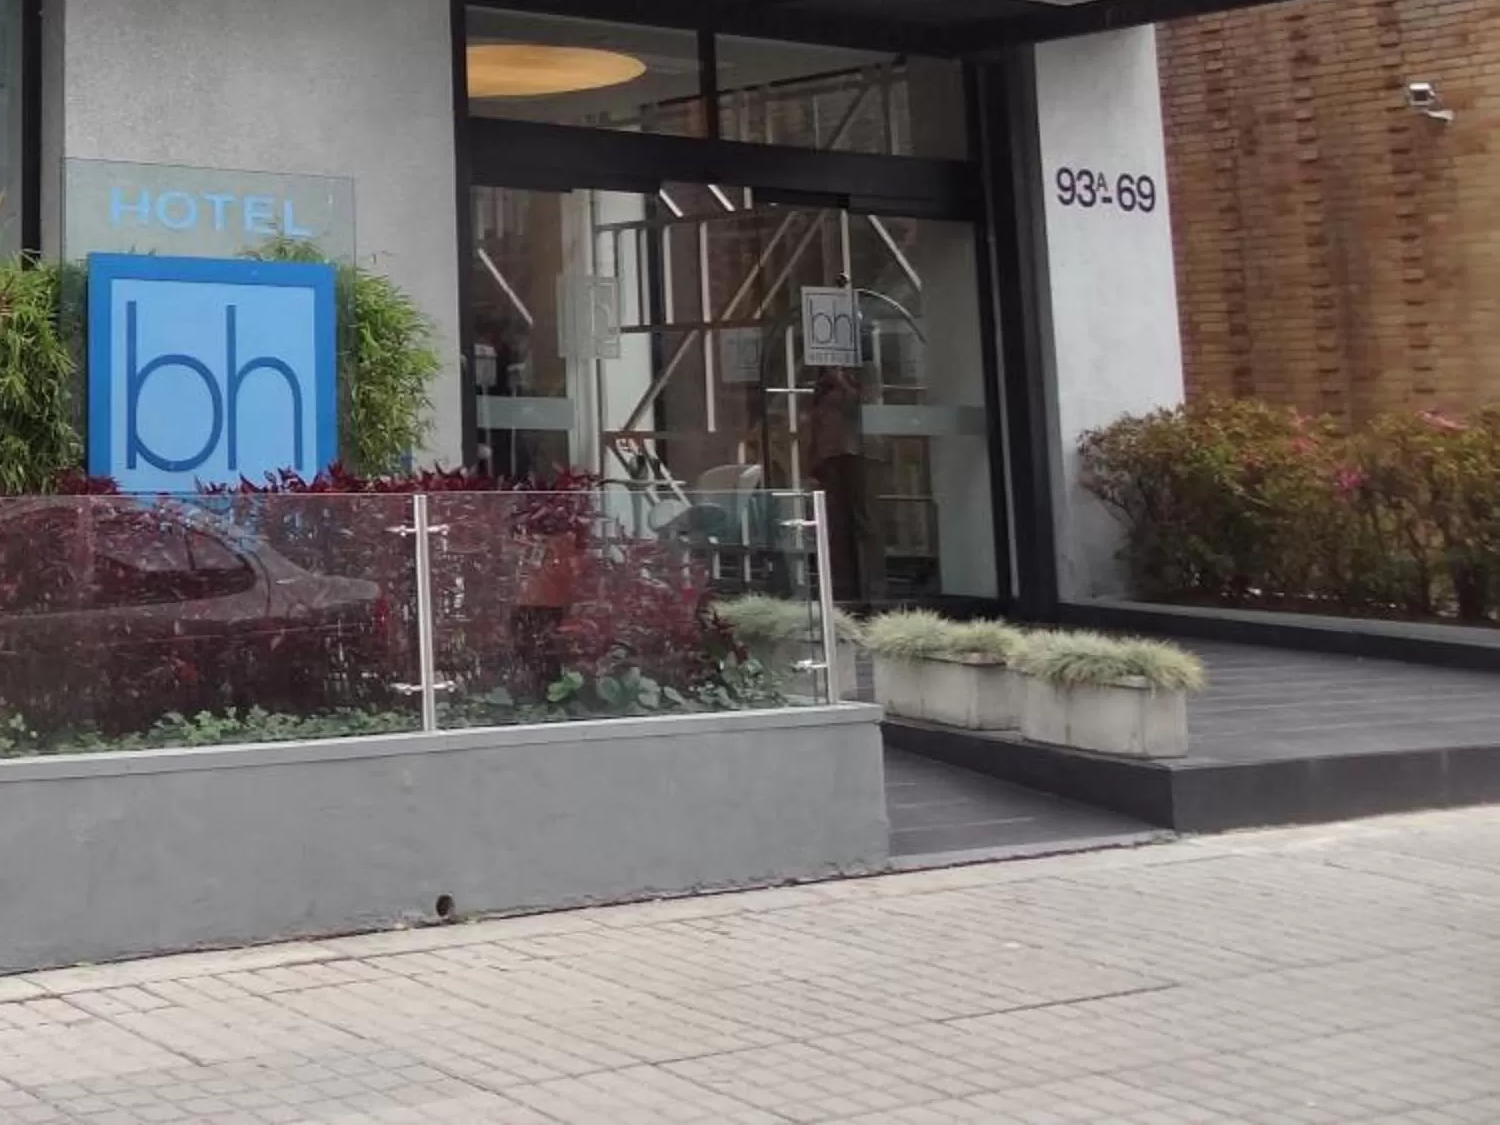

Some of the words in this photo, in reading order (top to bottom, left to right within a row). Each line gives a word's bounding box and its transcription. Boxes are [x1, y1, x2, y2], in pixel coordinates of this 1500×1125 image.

[110, 187, 313, 237] HOTEL
[809, 299, 853, 345] bh
[126, 300, 302, 472] bh
